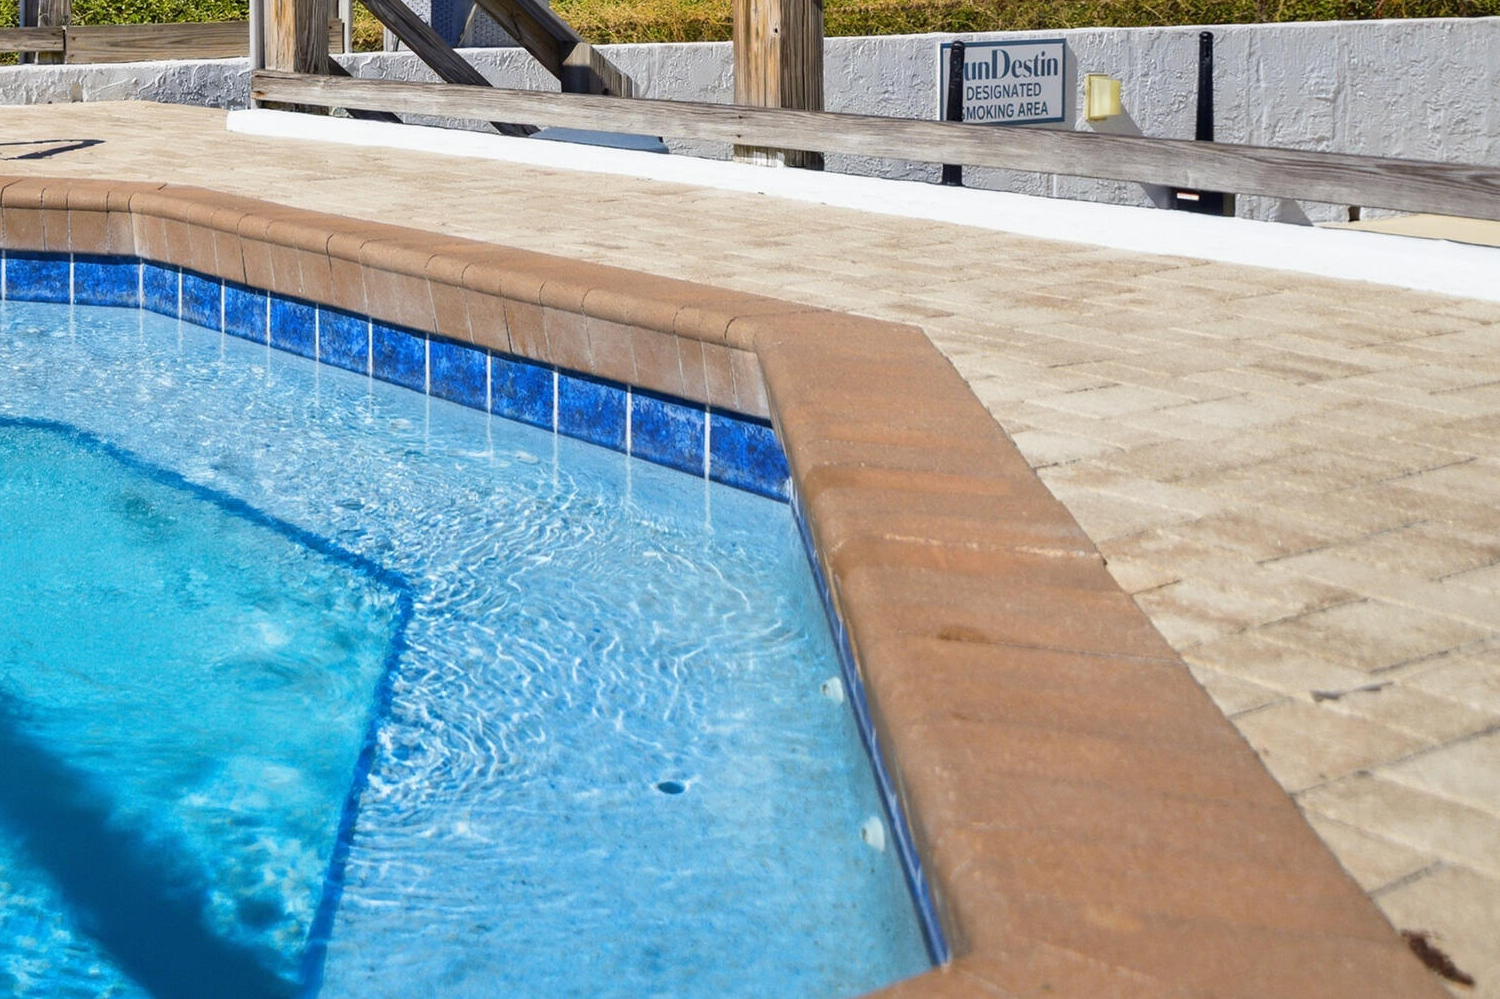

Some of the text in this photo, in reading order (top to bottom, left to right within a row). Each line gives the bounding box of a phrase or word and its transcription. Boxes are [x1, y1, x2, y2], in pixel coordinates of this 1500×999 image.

[963, 49, 1058, 81] unDestin
[967, 83, 1041, 101] DESIGNATED
[1018, 102, 1048, 117] AREA
